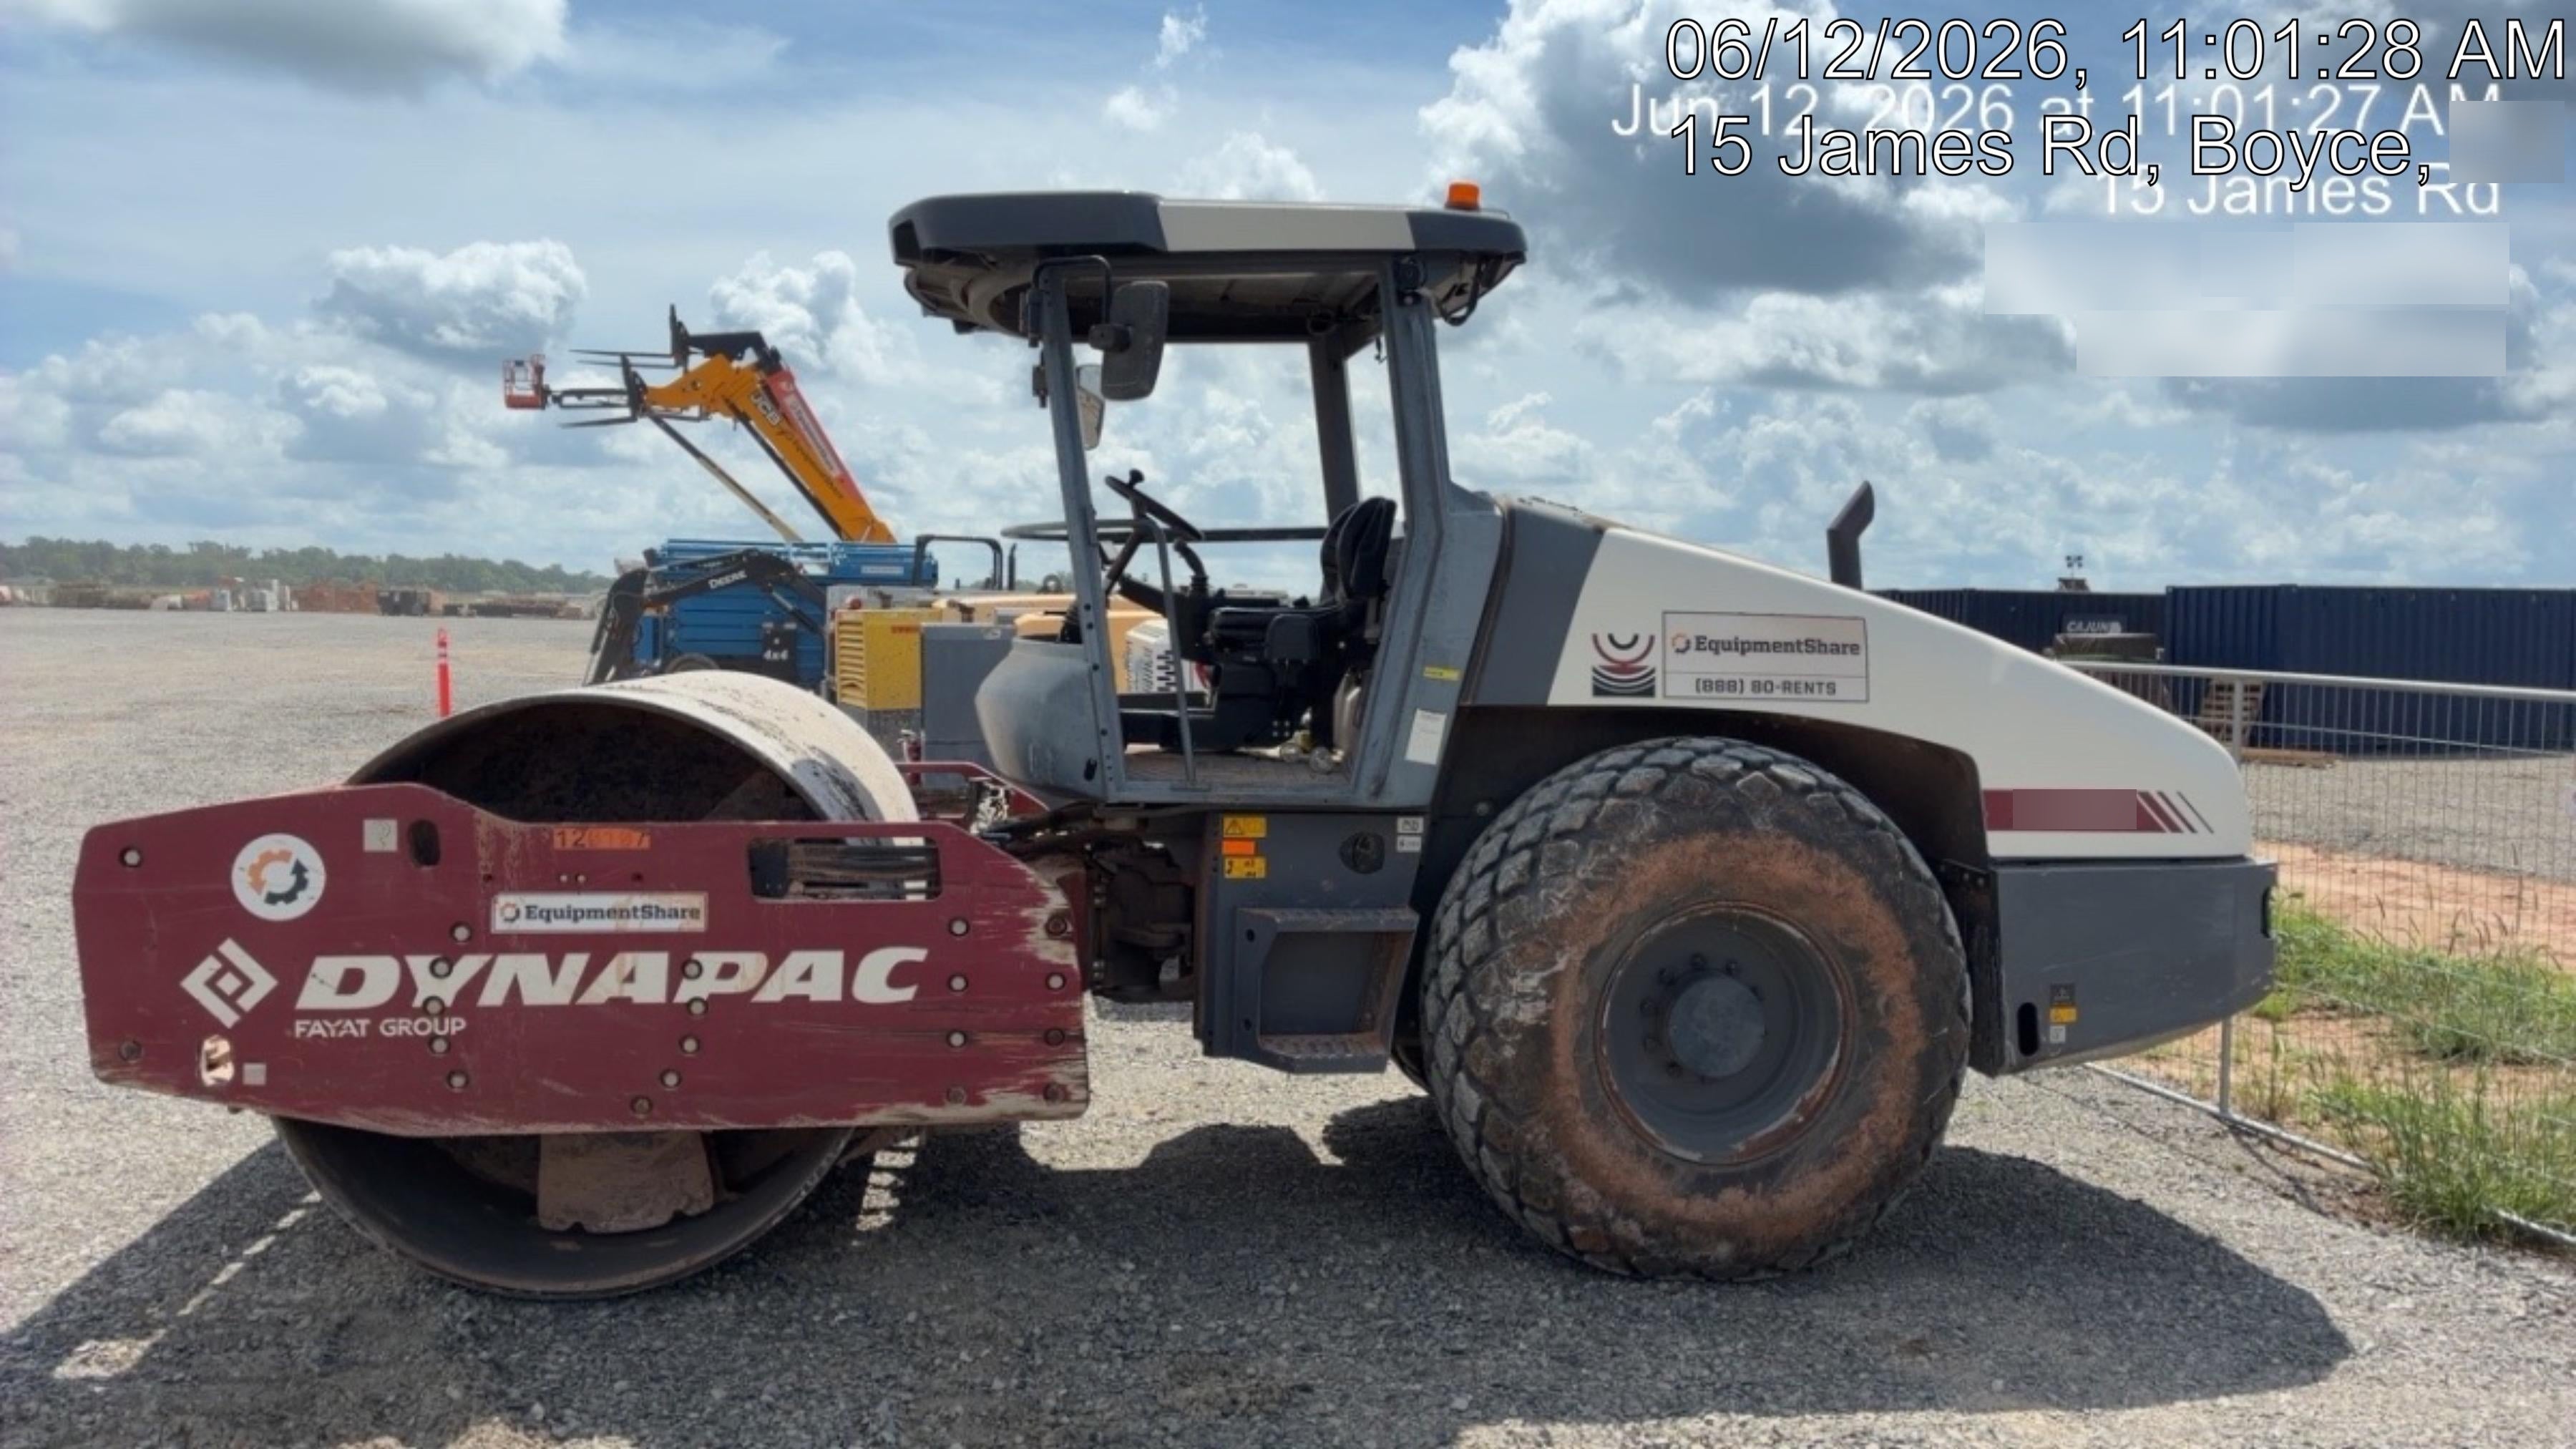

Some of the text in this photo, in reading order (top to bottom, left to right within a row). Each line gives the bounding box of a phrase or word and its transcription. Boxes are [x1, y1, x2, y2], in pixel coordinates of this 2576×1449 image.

[1694, 634, 1861, 656] EquipmentShare
[1694, 677, 1837, 696] (888) 80-RENTS
[524, 904, 701, 924] EquipmentShare
[294, 946, 929, 1010] DYNAPAC
[294, 1017, 467, 1038] FAYAT GROUP
